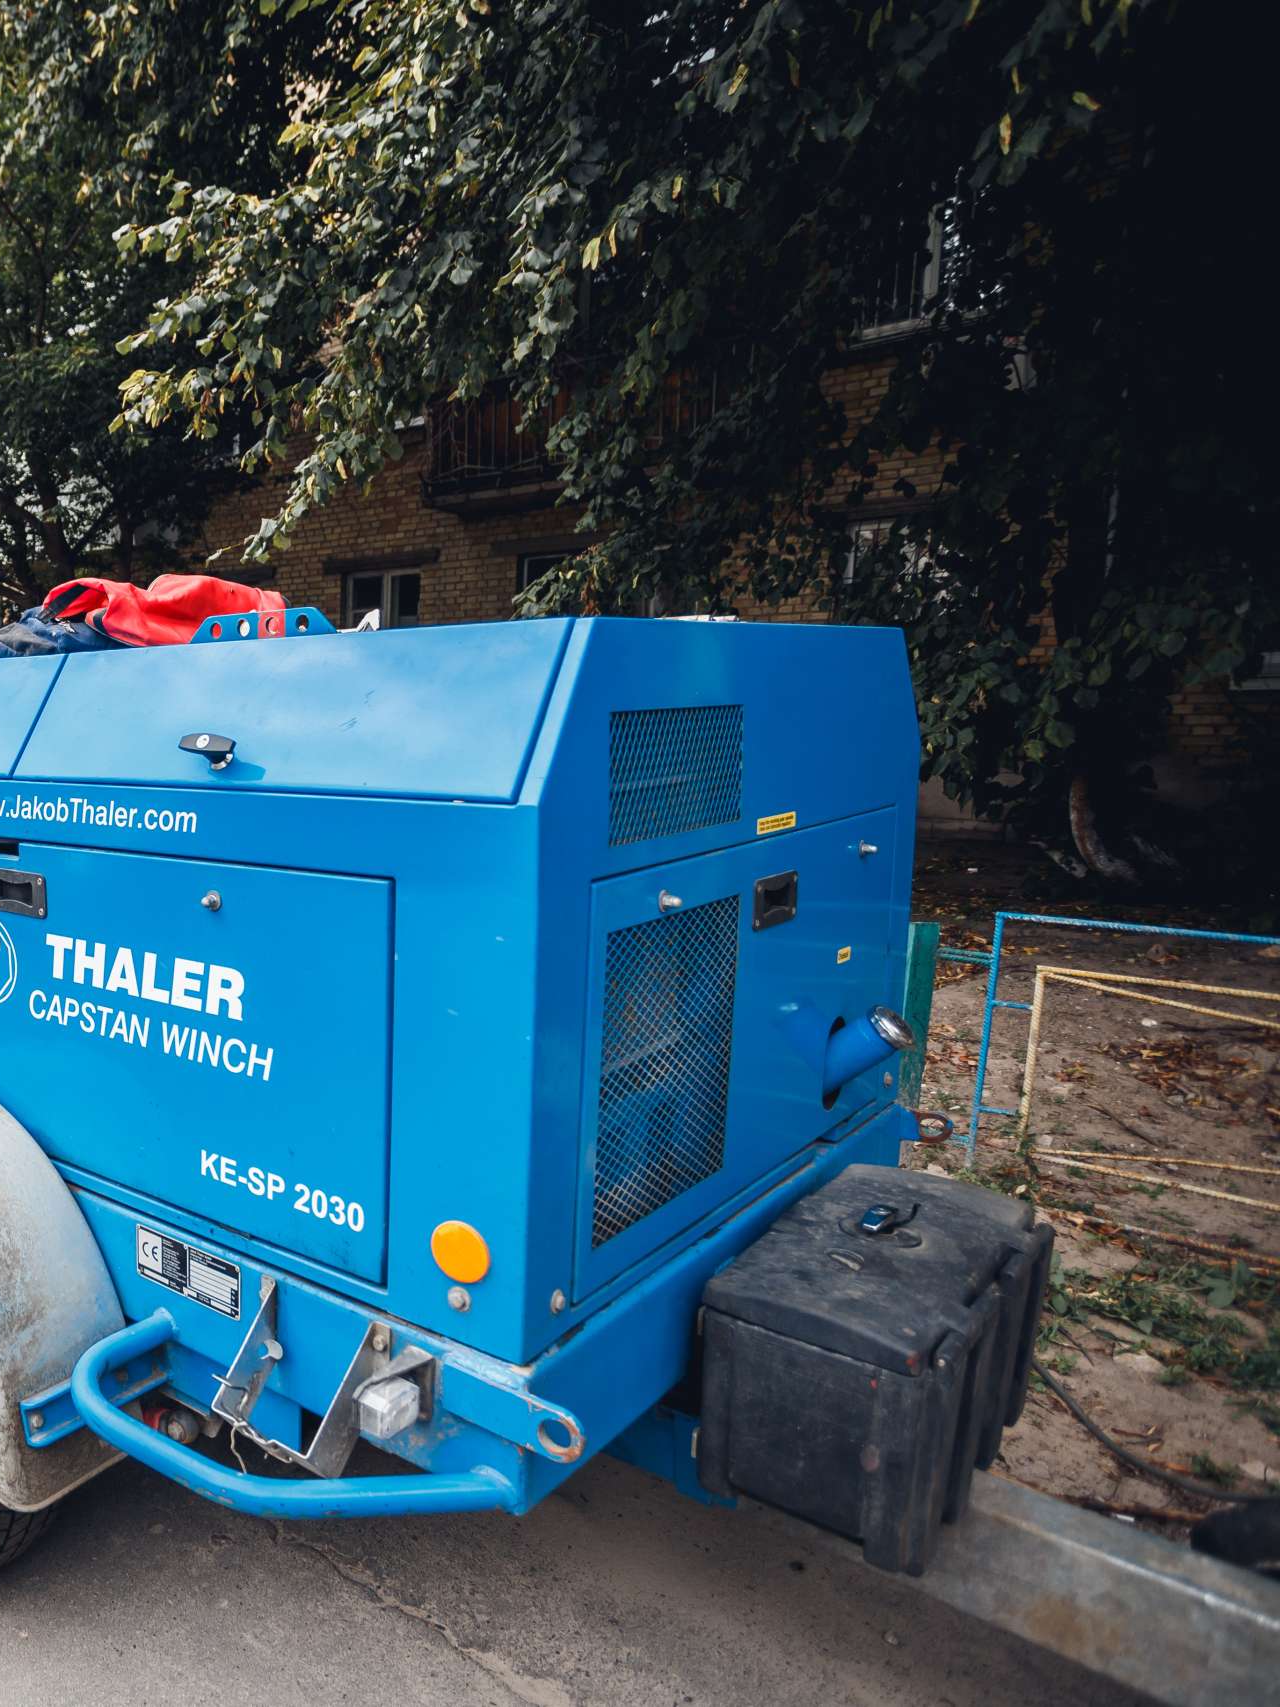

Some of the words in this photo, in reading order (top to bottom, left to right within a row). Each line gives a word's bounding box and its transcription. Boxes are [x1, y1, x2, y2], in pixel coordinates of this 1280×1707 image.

[45, 933, 246, 1022] THALER
[28, 989, 151, 1048] CAPSTAN
[161, 1021, 275, 1082] WINCH
[200, 1149, 286, 1201] KE-SP
[293, 1183, 365, 1233] 2030
[142, 1241, 159, 1262] CE
